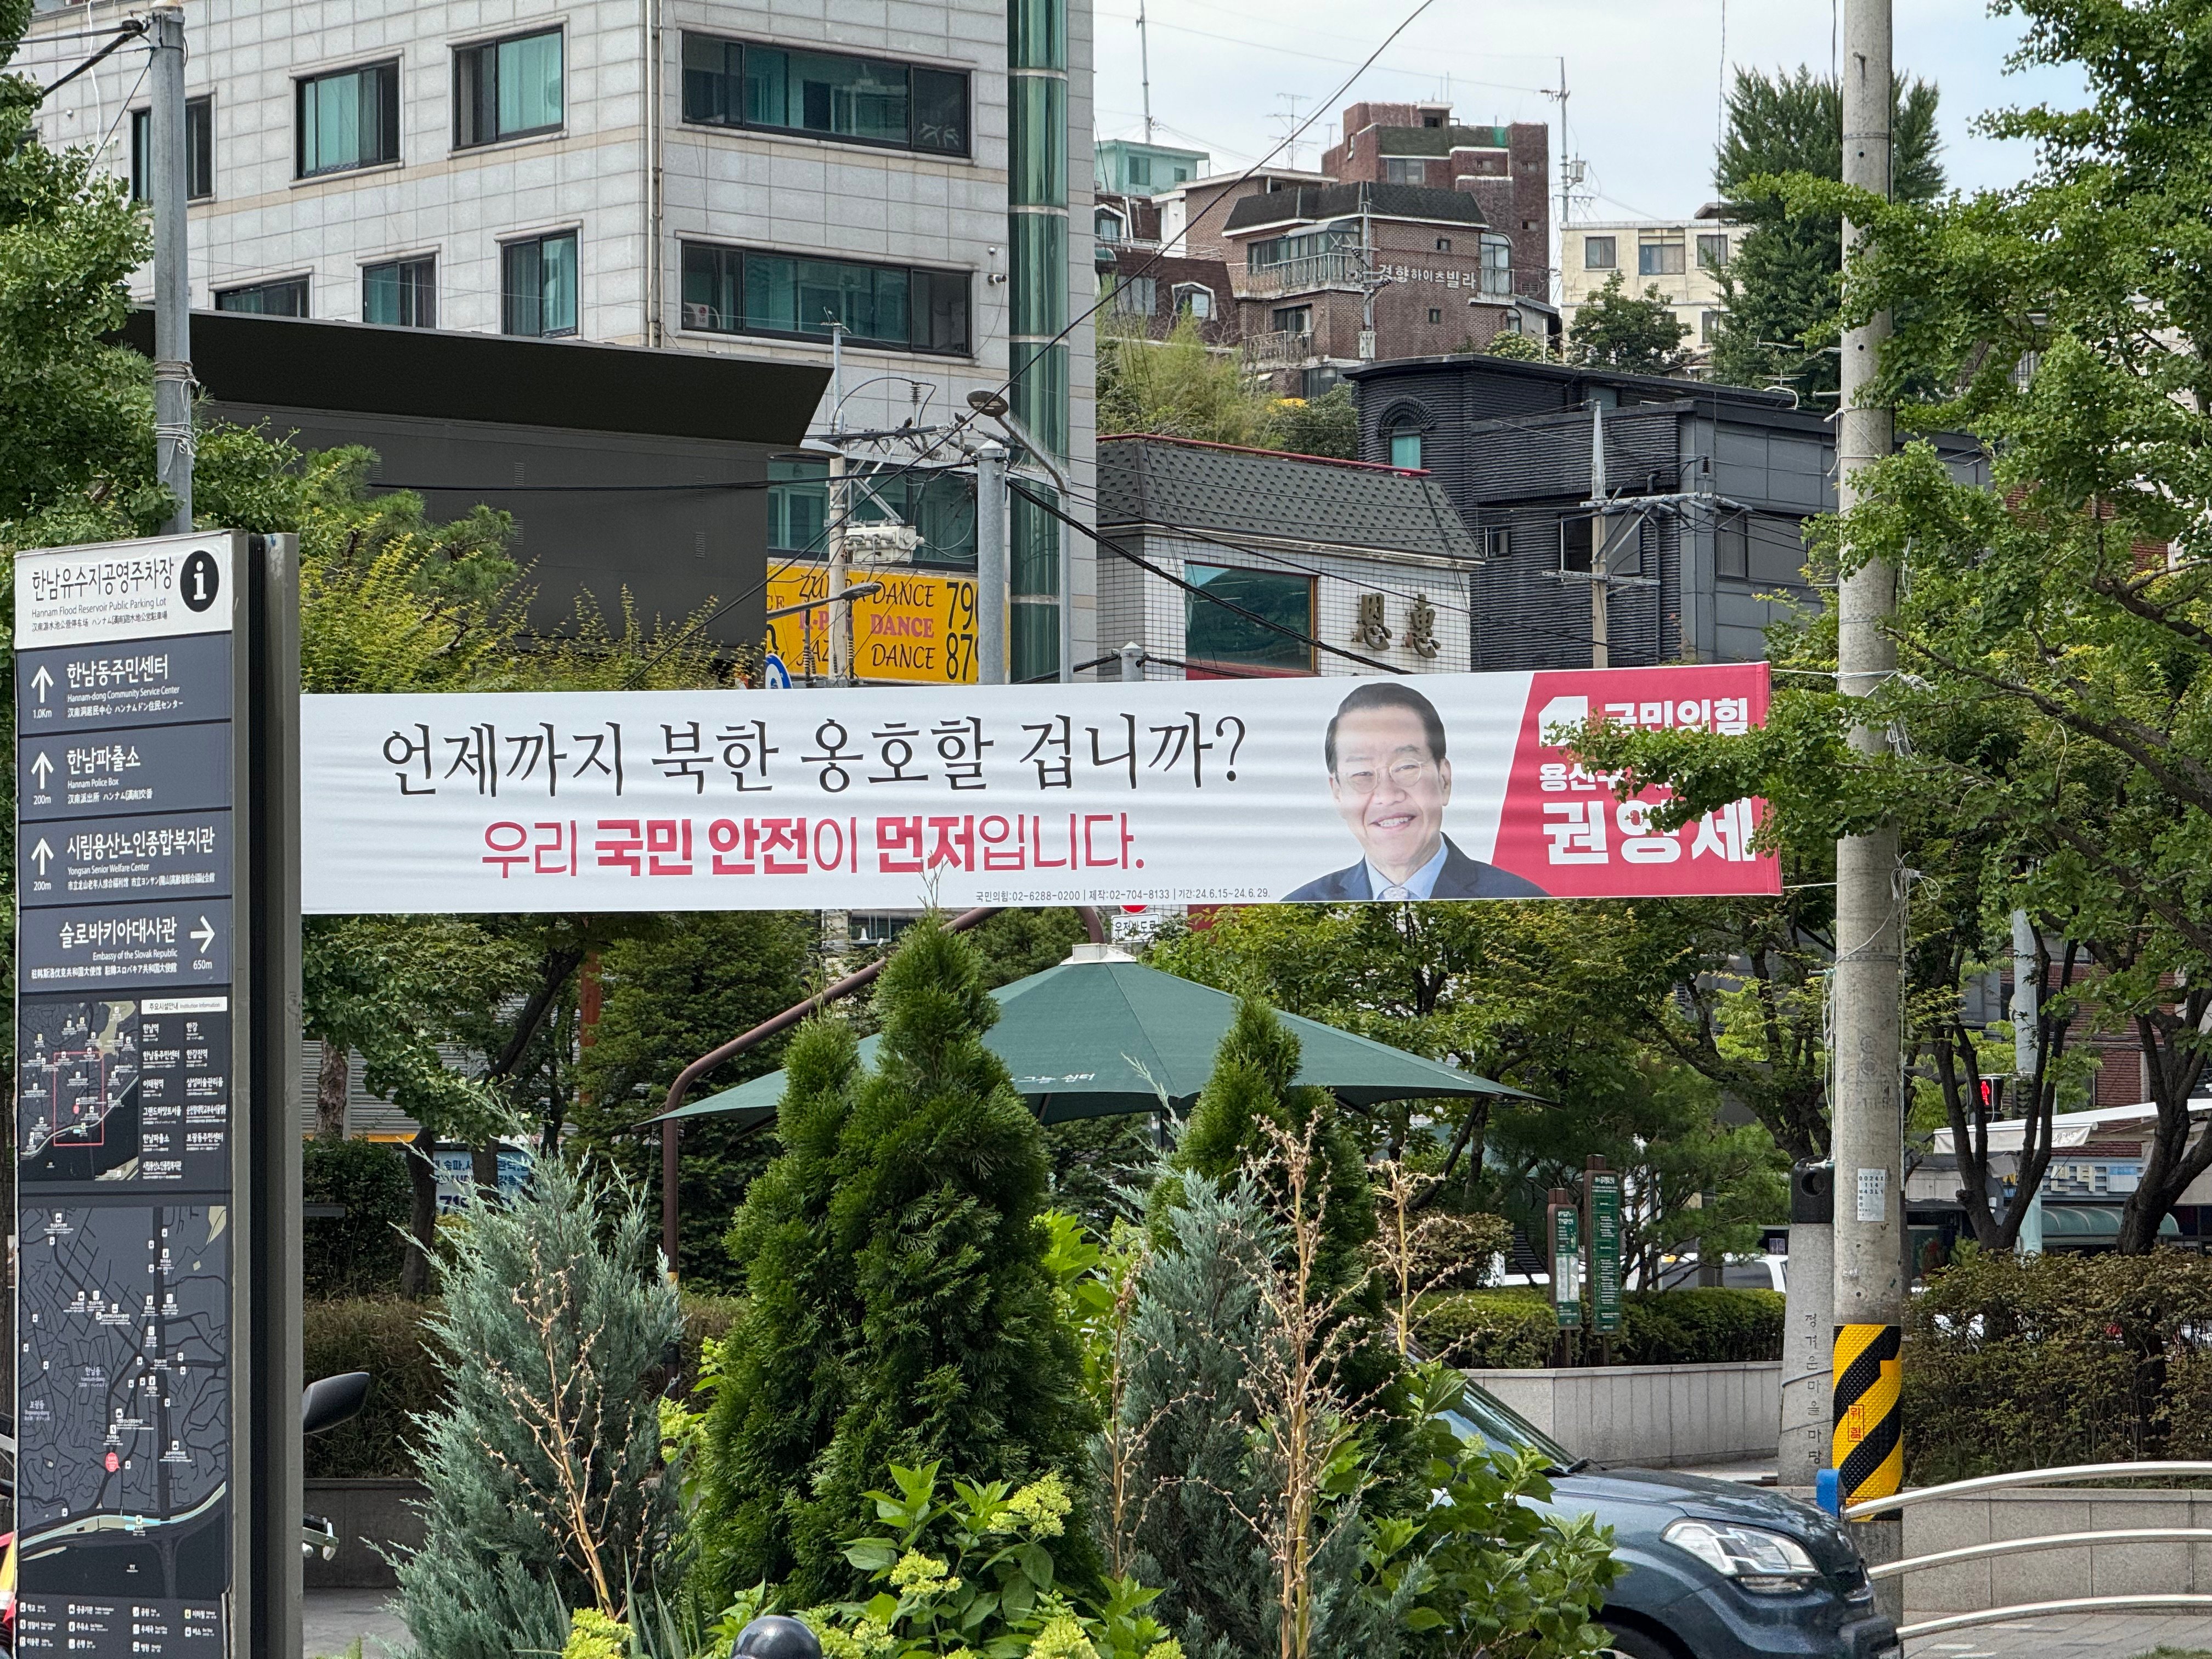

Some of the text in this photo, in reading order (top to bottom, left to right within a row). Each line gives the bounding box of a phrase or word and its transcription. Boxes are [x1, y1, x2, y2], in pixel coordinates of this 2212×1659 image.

[32, 556, 174, 601] 한남유수지공영주차장
[32, 596, 166, 618] Hannam Flood Reservoir Public Parking Lot
[873, 582, 936, 607] DANCE
[947, 582, 979, 630] 79
[871, 614, 935, 638] DANCE
[871, 644, 936, 669] DANCE
[946, 632, 979, 682] 87
[67, 654, 168, 689] 한남동주민센터
[67, 685, 180, 703] Hannam-dong Community Service Center
[32, 708, 52, 719] 1.0Km
[67, 745, 141, 775] 한남파출소
[383, 712, 1246, 798] 언제까지 북한 옹호할 겁니까?
[67, 777, 119, 789] Hannam Police Box
[33, 794, 52, 805] 200m
[67, 826, 215, 861] 시립용산노인종합복지관
[1542, 797, 1757, 865] 권영세
[482, 811, 1146, 879] 우리 국민 안전이 먼저입니다.
[67, 862, 150, 878] Yongsan Senior Welfare Center
[33, 881, 52, 891] 200m
[976, 890, 1081, 902] 국민의힘:02-6288-0200
[1089, 888, 1170, 901] 제작:02-704-8133
[60, 916, 178, 949] 슬로바키아대사관
[93, 947, 178, 963] Embassy of the Slovak Republic
[193, 960, 213, 970] 650m
